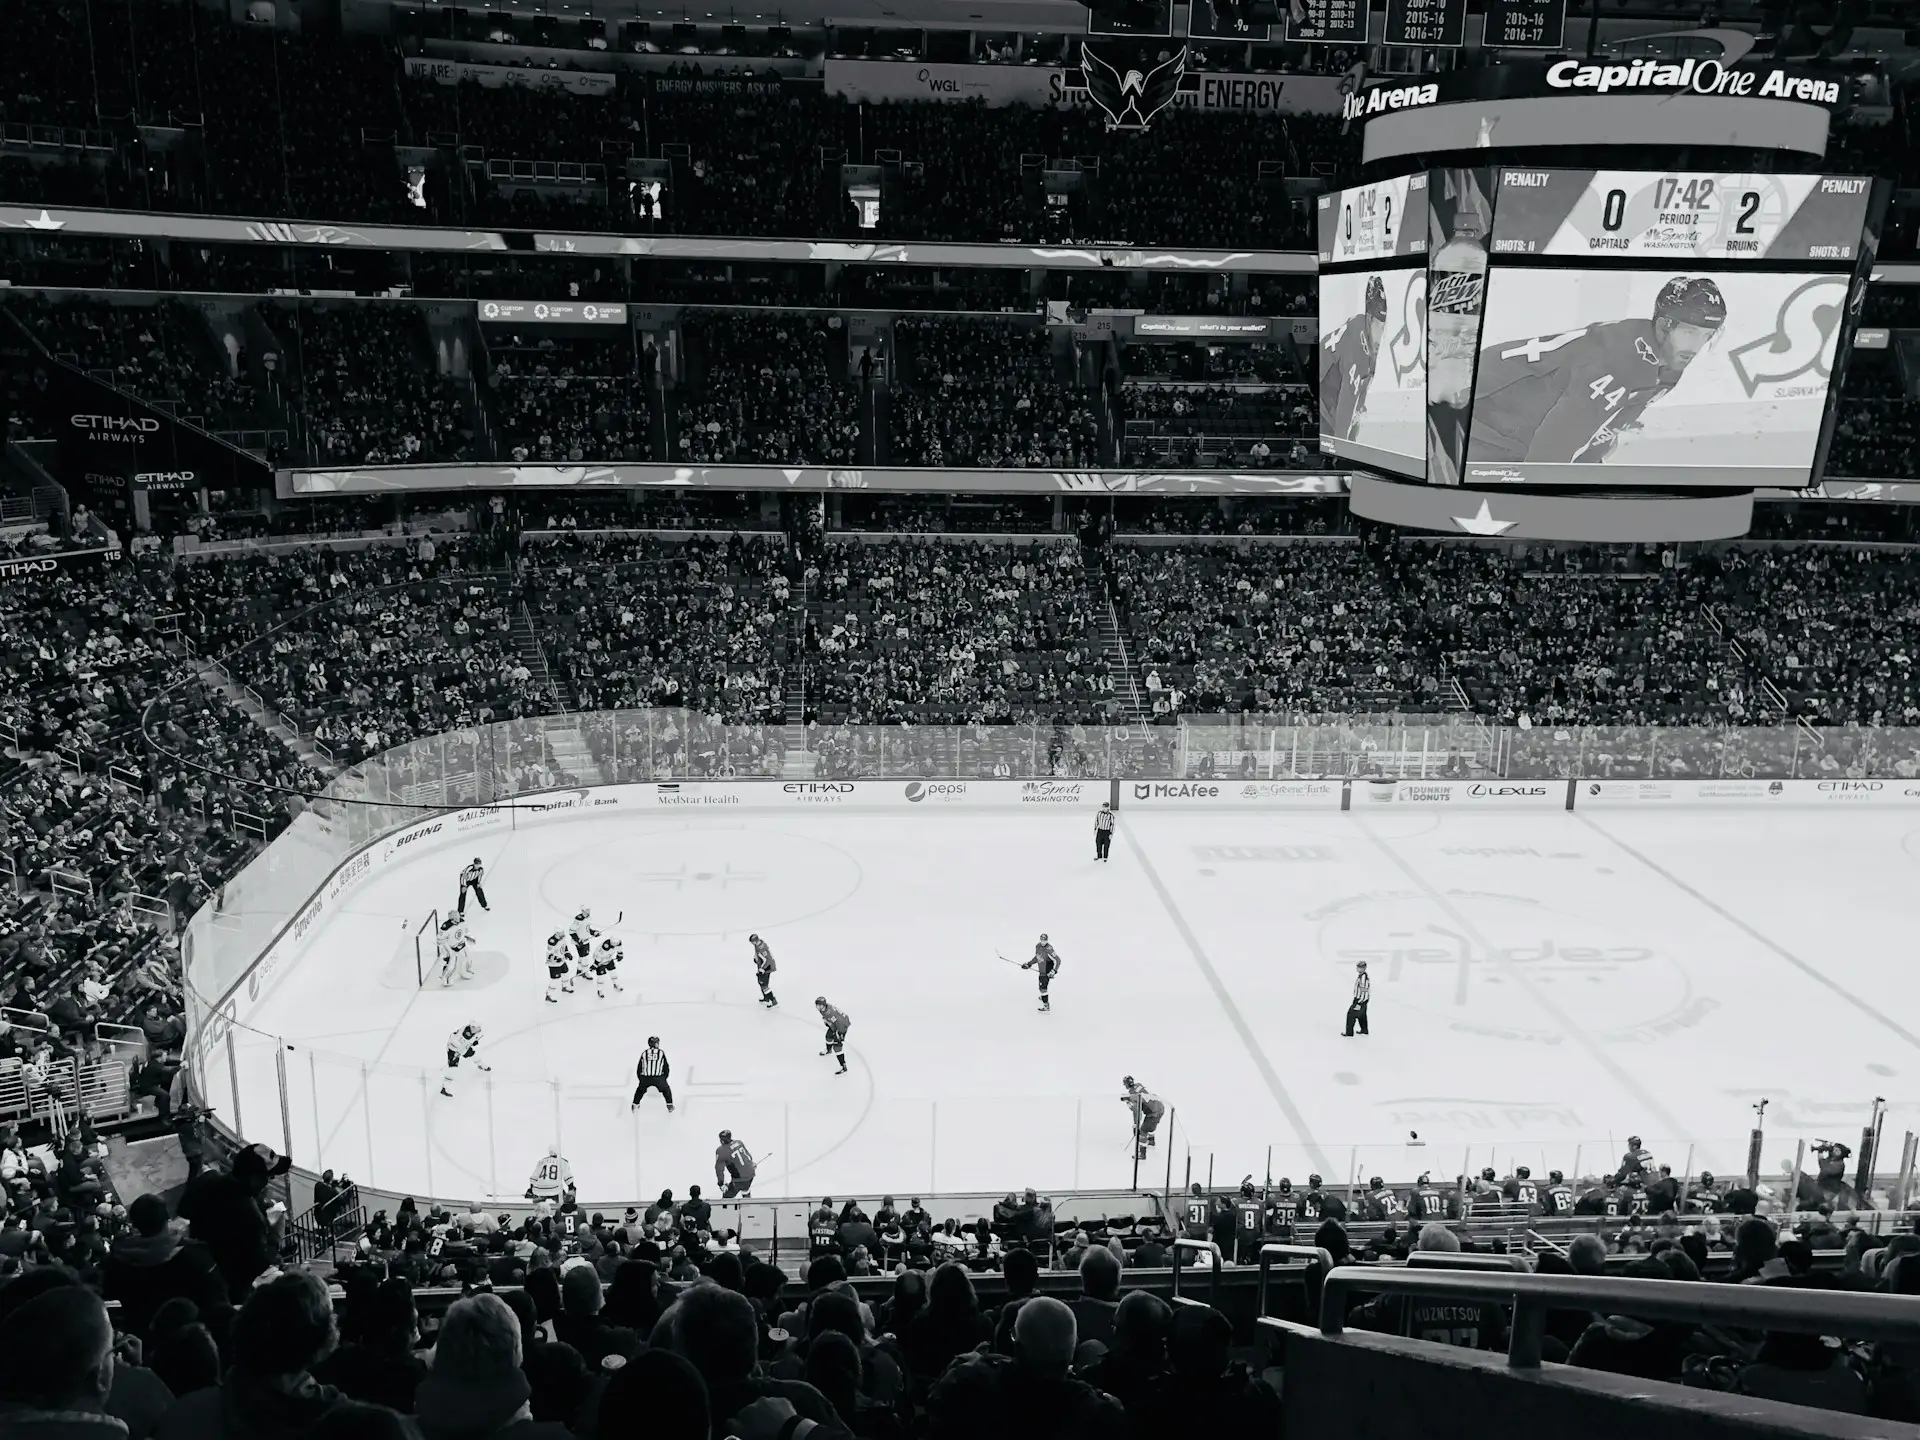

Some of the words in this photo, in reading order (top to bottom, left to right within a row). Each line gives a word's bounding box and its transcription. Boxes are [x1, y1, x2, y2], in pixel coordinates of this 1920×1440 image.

[1330, 10, 1355, 19] 2010-11
[1405, 11, 1445, 25] 2015-16
[1505, 12, 1544, 26] 2015-16
[1330, 20, 1355, 28] 2012-13
[1404, 27, 1444, 40] 2016-17
[1503, 28, 1544, 41] 2016-17
[411, 63, 427, 77] WE
[656, 79, 692, 93] ENERGY
[747, 82, 767, 95] ASK
[929, 80, 960, 93] WGL
[1759, 70, 1839, 104] Arena
[1204, 79, 1285, 110] ENERGY
[1366, 83, 1439, 114] Arena
[1504, 173, 1549, 187] PENALTY
[1821, 180, 1866, 194] PENALTY
[1653, 178, 1714, 210] 17:42
[1384, 196, 1392, 235] 2
[1602, 189, 1627, 231] 0
[1735, 192, 1760, 234] 2
[1345, 204, 1352, 240] 0
[1659, 214, 1691, 224] PERIOD
[1692, 214, 1699, 224] 2
[1660, 228, 1702, 244] Sports
[1495, 240, 1526, 252] SHOTS:
[1589, 237, 1630, 250] CAPITALS
[1726, 240, 1759, 251] BRUINS
[1809, 246, 1840, 258] SHOTS:
[1097, 322, 1111, 330] 215
[1294, 325, 1308, 333] 215
[1589, 374, 1626, 411] 44
[70, 414, 160, 432] ETIHAD
[88, 432, 145, 443] AIRWAYS
[84, 472, 126, 487] ETIHAD
[134, 471, 195, 483] ETIHAD
[146, 482, 185, 491] AIRWAYS
[103, 550, 122, 561] 115
[783, 783, 855, 793] ETIHAD
[928, 782, 967, 796] pepsi
[1038, 782, 1084, 796] Sports
[1154, 784, 1219, 798] McAfee
[1303, 784, 1331, 793] Turtle
[1489, 787, 1547, 796] LEXUS
[1817, 782, 1884, 791] ETIHAD
[594, 797, 618, 806] Bank
[658, 795, 701, 805] MedStar
[704, 795, 739, 804] Health
[796, 795, 843, 803] AIRWAYS
[1022, 795, 1080, 803] WASHINGTON
[396, 823, 442, 848] BOEING
[731, 1147, 752, 1167] 77
[538, 1164, 558, 1181] 48
[1518, 1187, 1538, 1204] 43
[1424, 1196, 1440, 1215] 10
[1189, 1206, 1205, 1224] 31
[1244, 1210, 1255, 1230] 8
[1277, 1208, 1296, 1226] 39
[564, 1216, 575, 1234] 8
[430, 1237, 443, 1256] 8
[1415, 1306, 1480, 1323] KUZNETSOV
